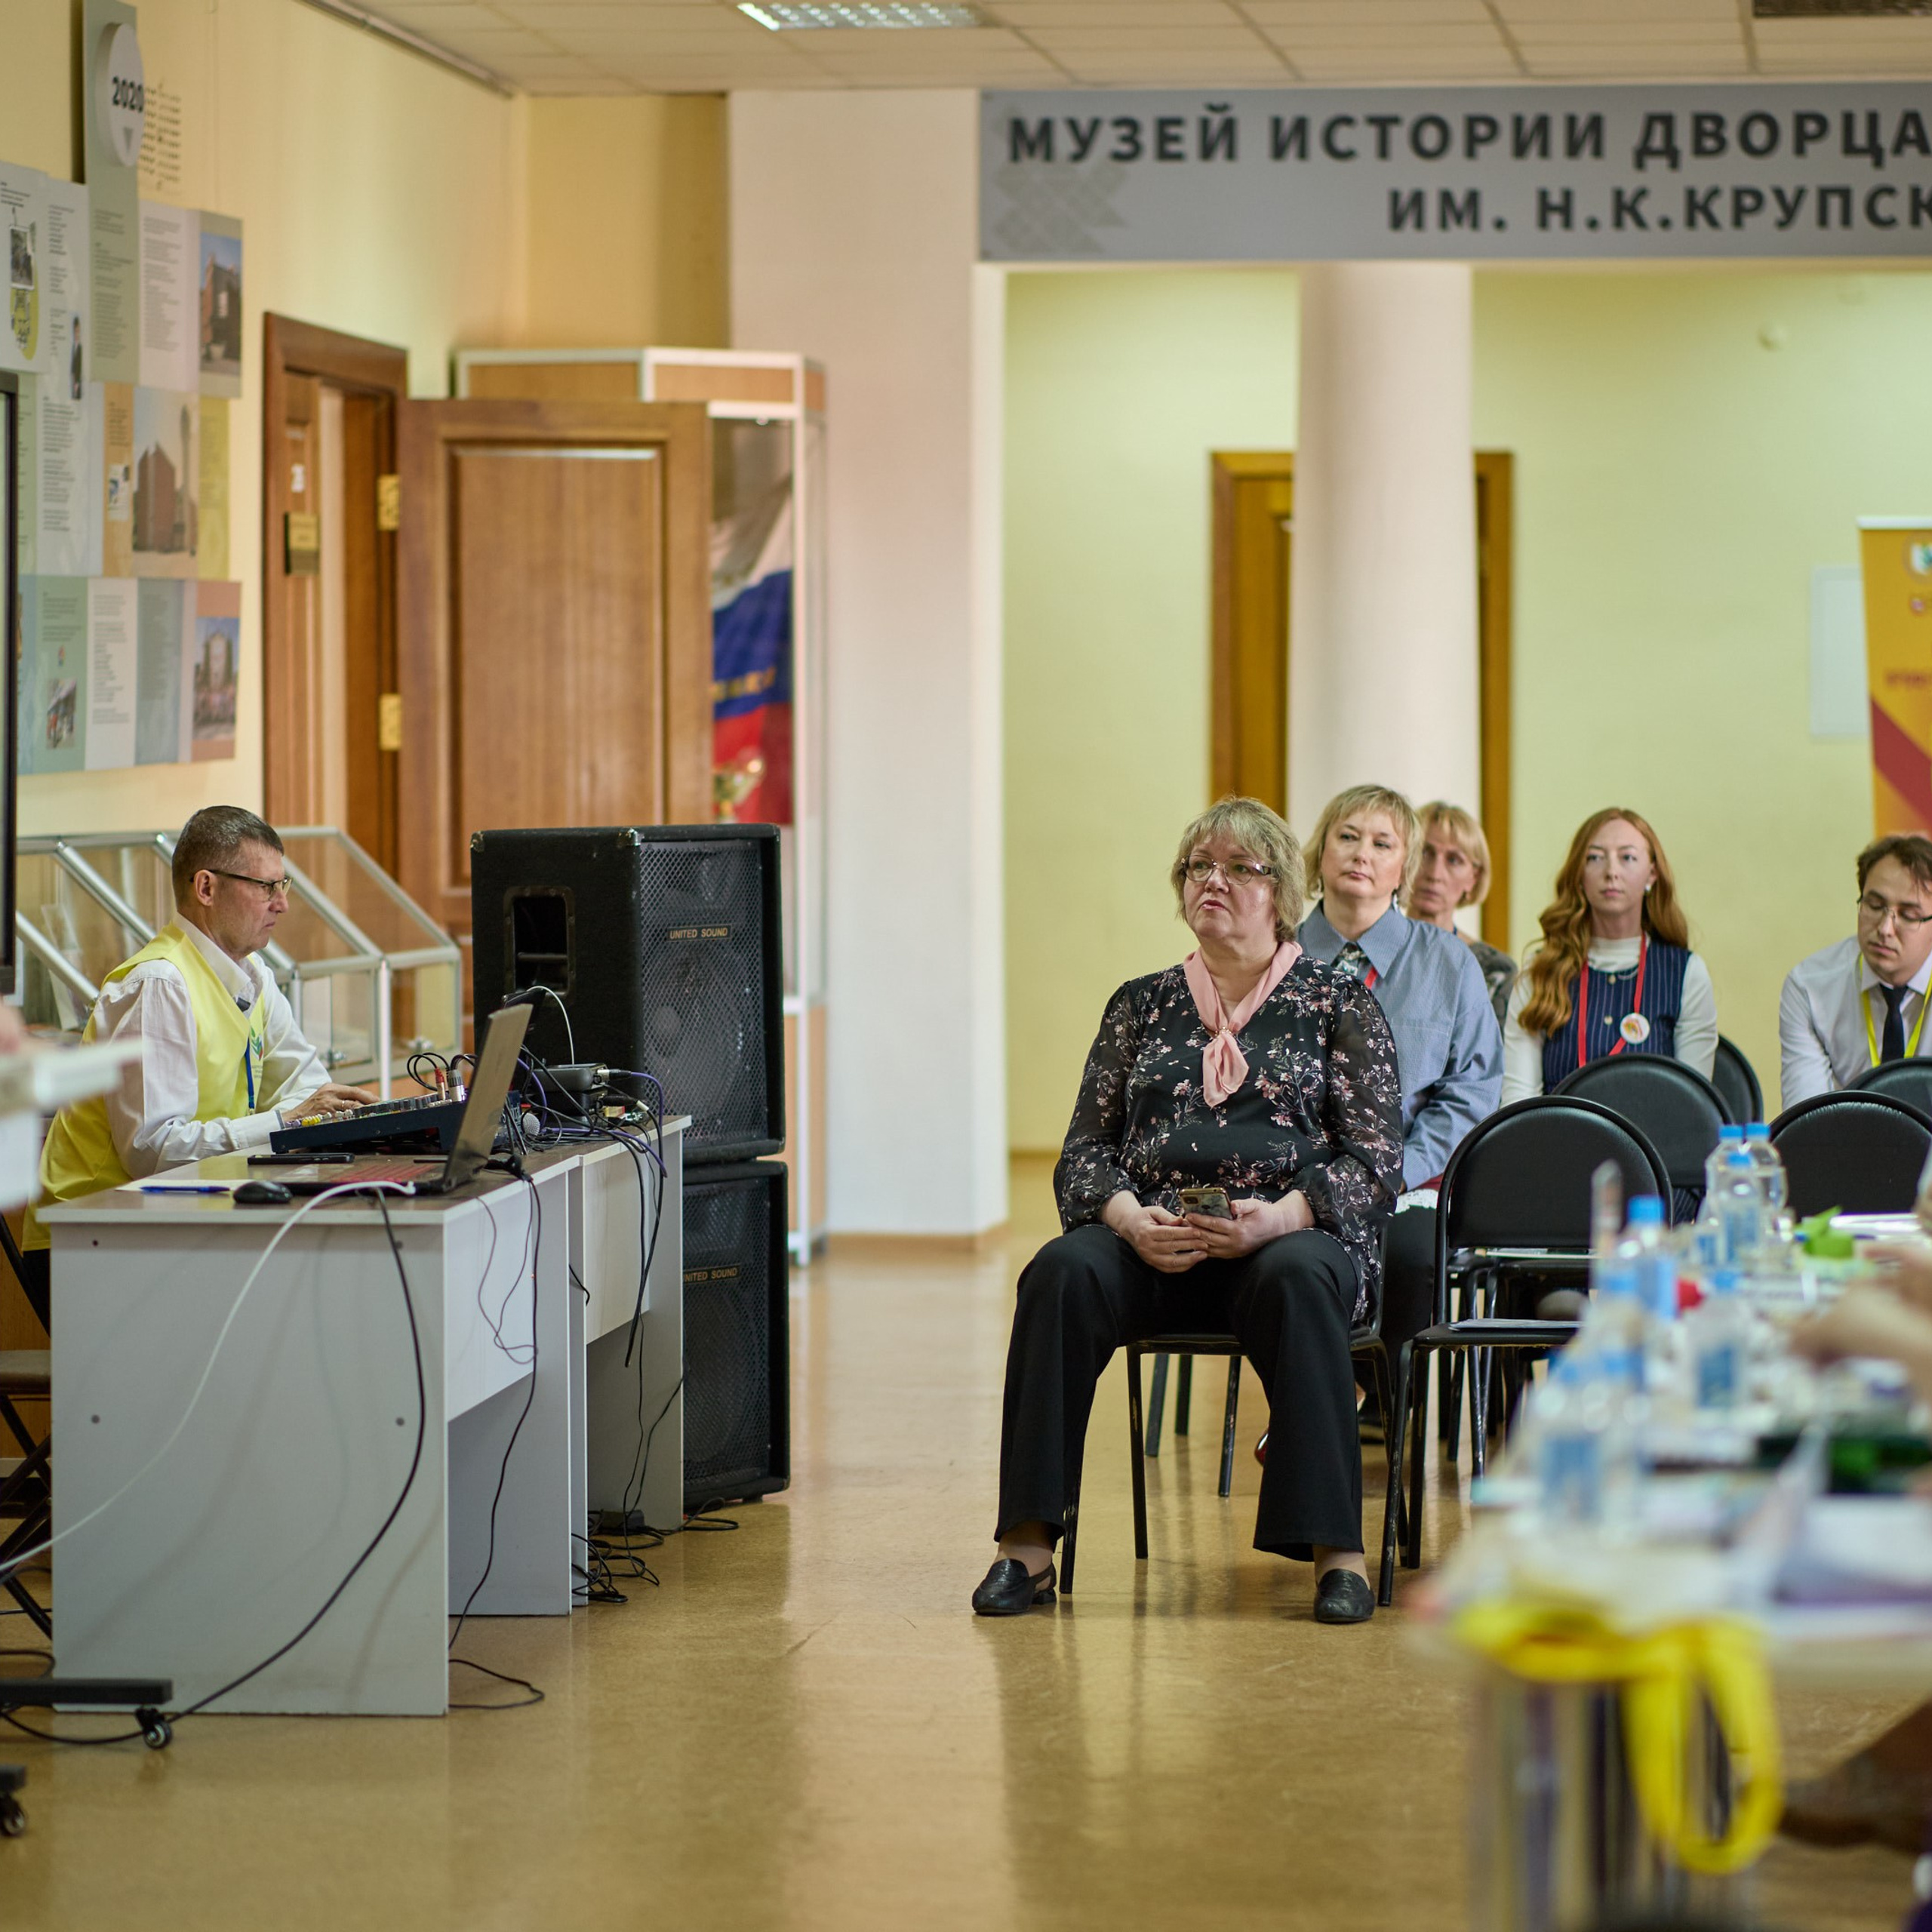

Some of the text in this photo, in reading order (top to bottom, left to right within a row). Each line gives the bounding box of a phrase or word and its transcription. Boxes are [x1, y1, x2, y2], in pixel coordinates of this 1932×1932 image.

[112, 76, 145, 113] 2020
[1010, 103, 1932, 171] МУЗЕЙ ИСТОРИИ ДВОРЦА
[1390, 189, 1507, 231] ИМ.
[669, 927, 728, 940] UNITED SOUND
[683, 1268, 737, 1282] NITED SOUND
